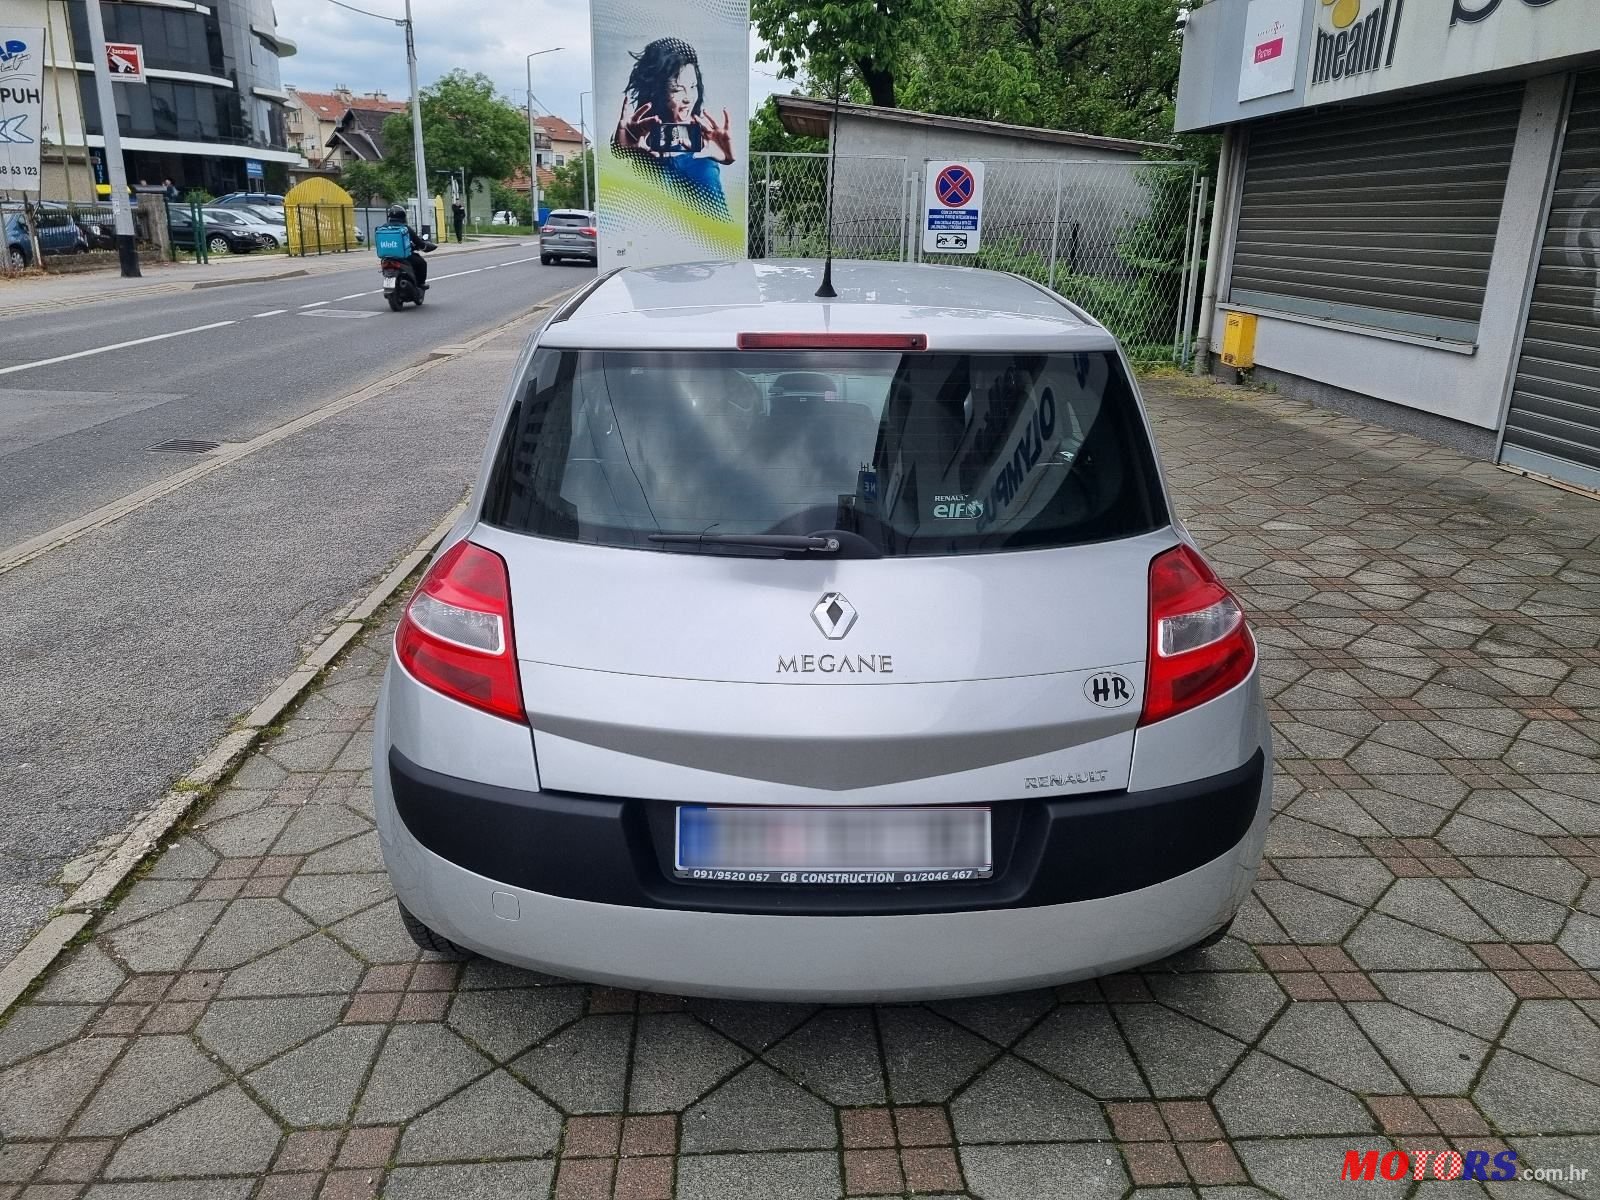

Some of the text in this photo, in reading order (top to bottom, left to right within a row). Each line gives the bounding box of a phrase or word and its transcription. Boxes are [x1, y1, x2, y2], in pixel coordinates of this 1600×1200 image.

[0, 165, 8, 175] 8
[23, 166, 38, 176] 123
[380, 240, 398, 249] Wolt
[933, 503, 966, 518] elf
[775, 654, 894, 674] MEGANE
[1092, 677, 1130, 702] HR
[1024, 769, 1109, 790] RENAULT
[692, 869, 974, 885] 091/9520 057 GB CONSTRUCTION 01/2046 467
